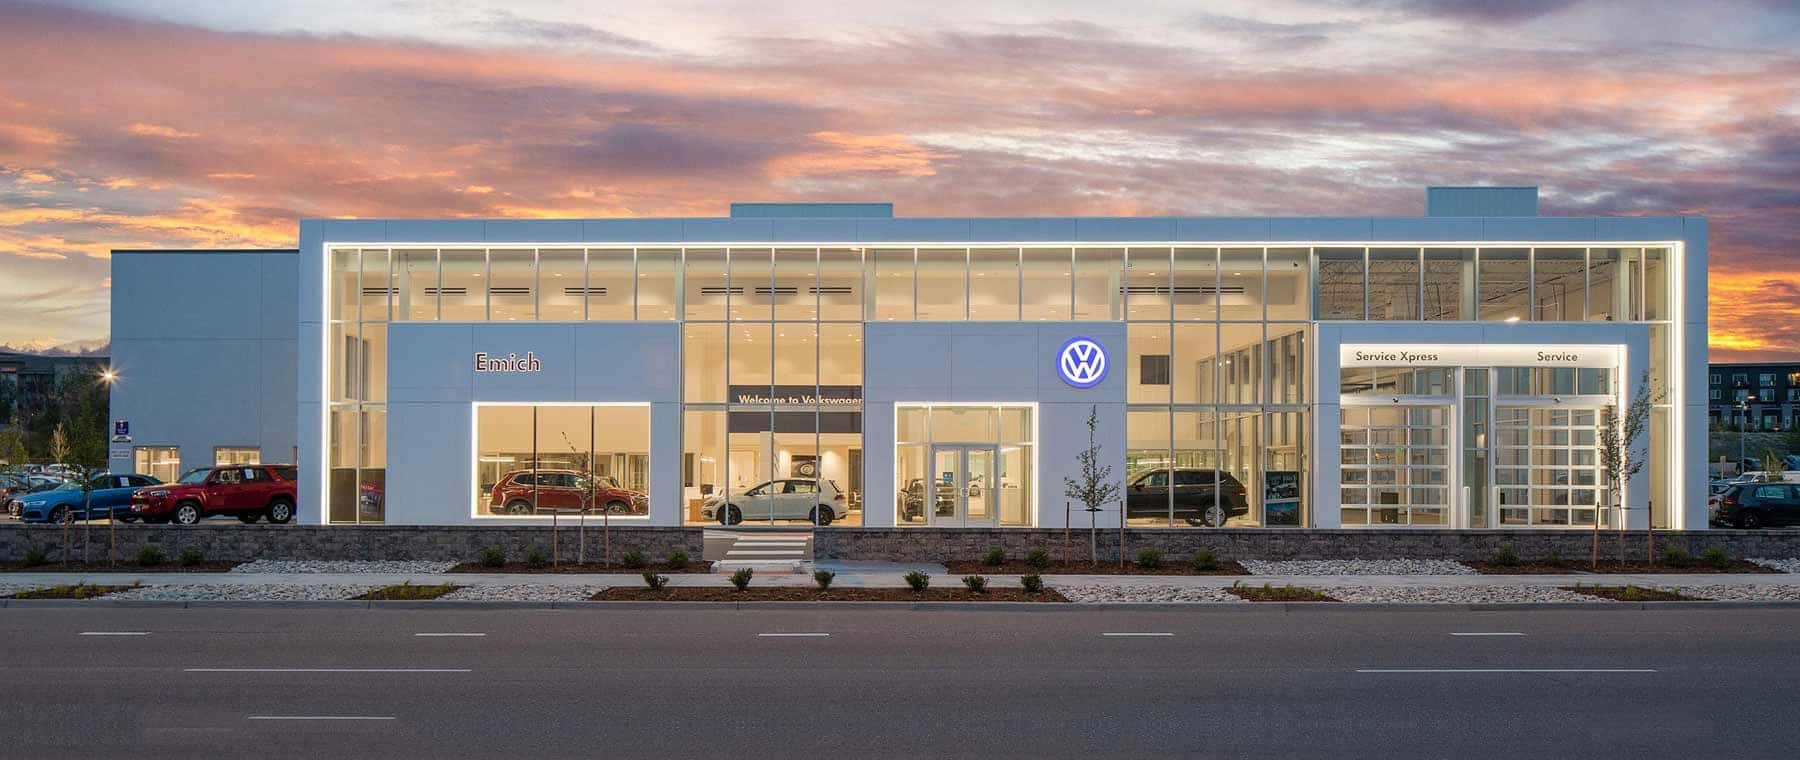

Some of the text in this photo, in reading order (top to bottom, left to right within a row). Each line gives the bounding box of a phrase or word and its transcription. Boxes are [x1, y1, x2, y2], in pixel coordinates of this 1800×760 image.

[475, 351, 541, 372] Emich
[1061, 340, 1105, 383] VW
[1356, 350, 1439, 364] Service Xpress
[1536, 351, 1578, 361] Service
[738, 394, 786, 404] Welcome
[789, 396, 799, 404] to
